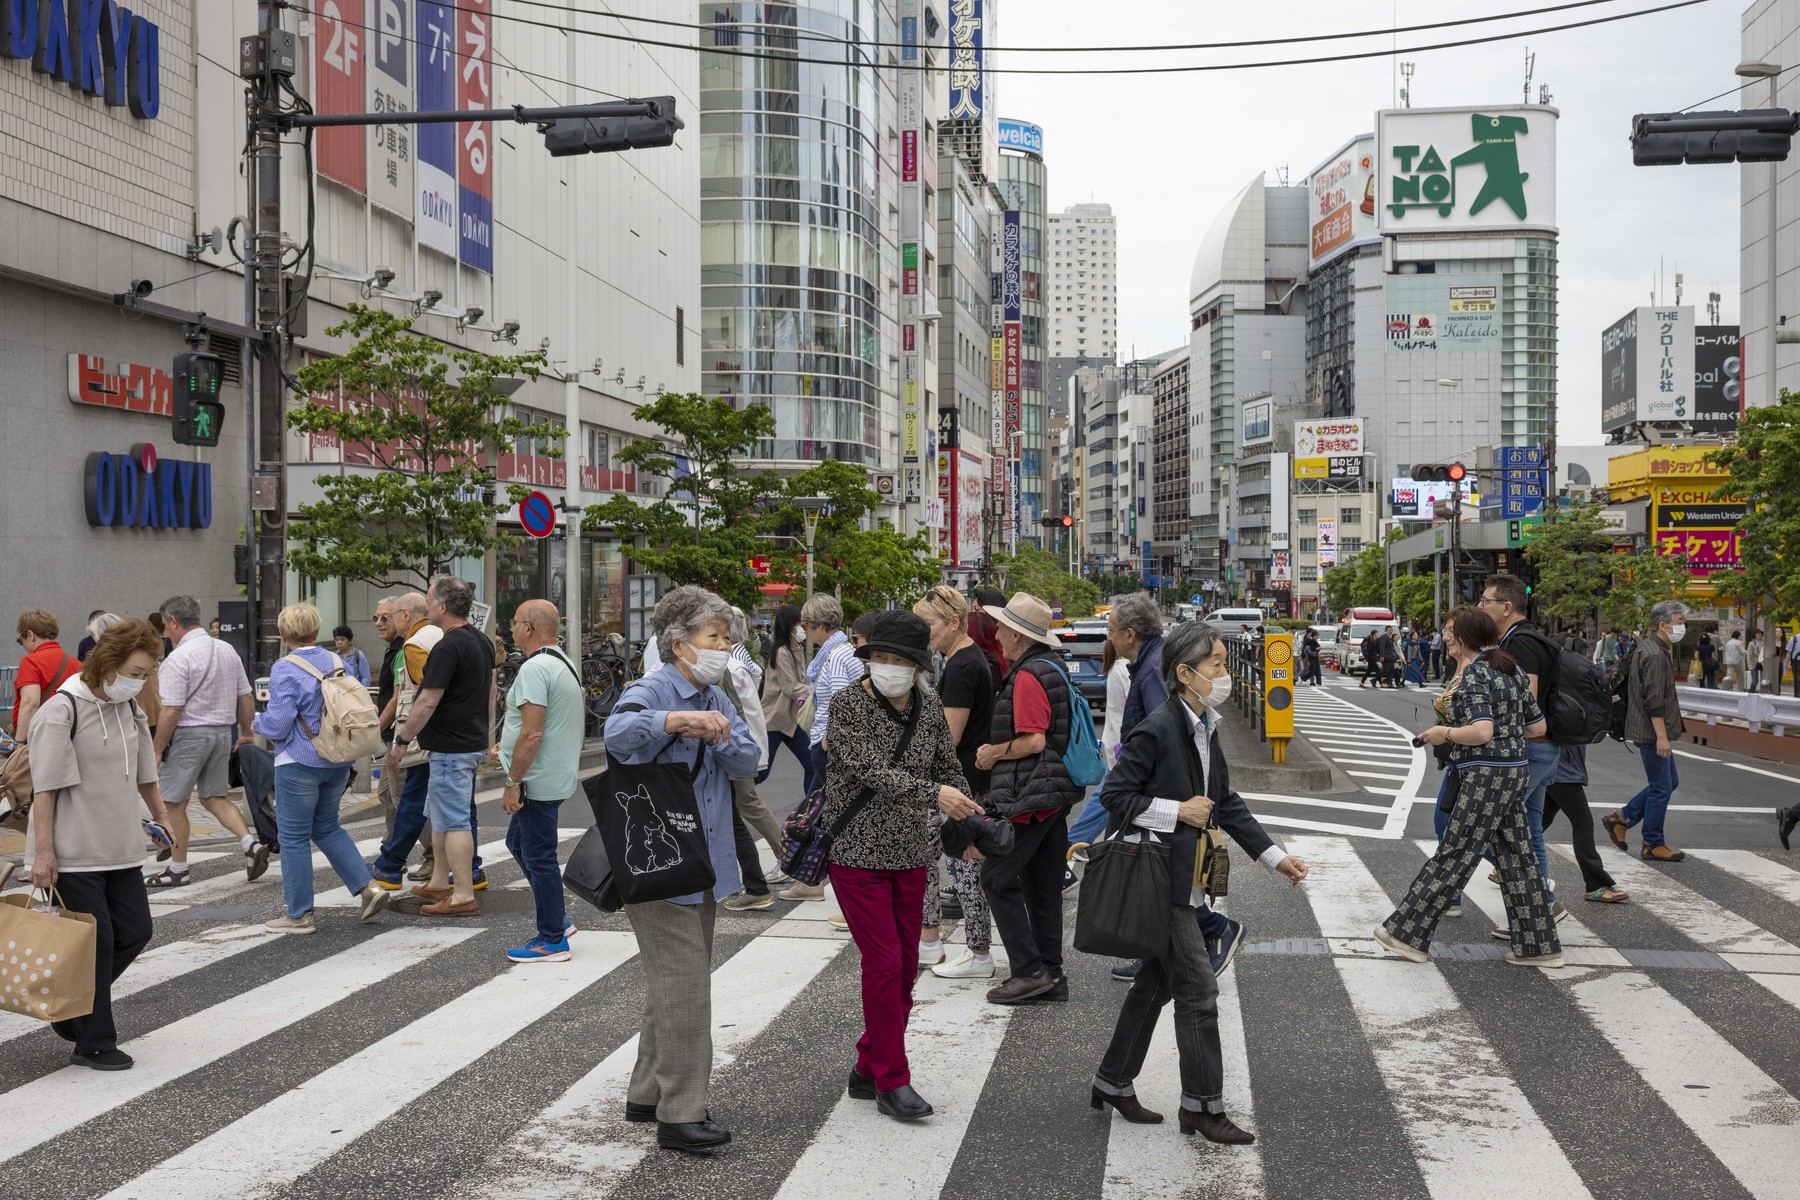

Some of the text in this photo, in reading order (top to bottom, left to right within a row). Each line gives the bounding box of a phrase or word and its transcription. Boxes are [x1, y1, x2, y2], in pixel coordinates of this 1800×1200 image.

[323, 0, 358, 77] 2F
[380, 0, 401, 64] P
[427, 23, 451, 72] 7F
[463, 0, 489, 175] える
[998, 126, 1042, 150] welcia
[422, 190, 453, 228] ODAKYU
[462, 212, 489, 249] ODAKYU
[1314, 211, 1350, 251] 大塚商会
[1004, 223, 1020, 309] カラオケの鉄人
[1441, 323, 1498, 338] Kaleido
[1655, 311, 1678, 321] THE
[1660, 322, 1674, 393] グローバル社
[938, 413, 951, 428] 24
[1648, 401, 1674, 413] global
[907, 420, 915, 451] クリニック
[1323, 425, 1353, 435] カラオケ
[1317, 438, 1358, 454] まねきねこ
[995, 459, 1003, 490] カラオケ
[1331, 458, 1361, 467] 隣のビル
[1348, 467, 1358, 475] 4F
[1527, 450, 1538, 496] 専門店
[97, 443, 211, 529] ODAKYU
[1510, 451, 1522, 512] お酒買取
[1686, 511, 1721, 520] Western
[1271, 669, 1287, 679] NERO
